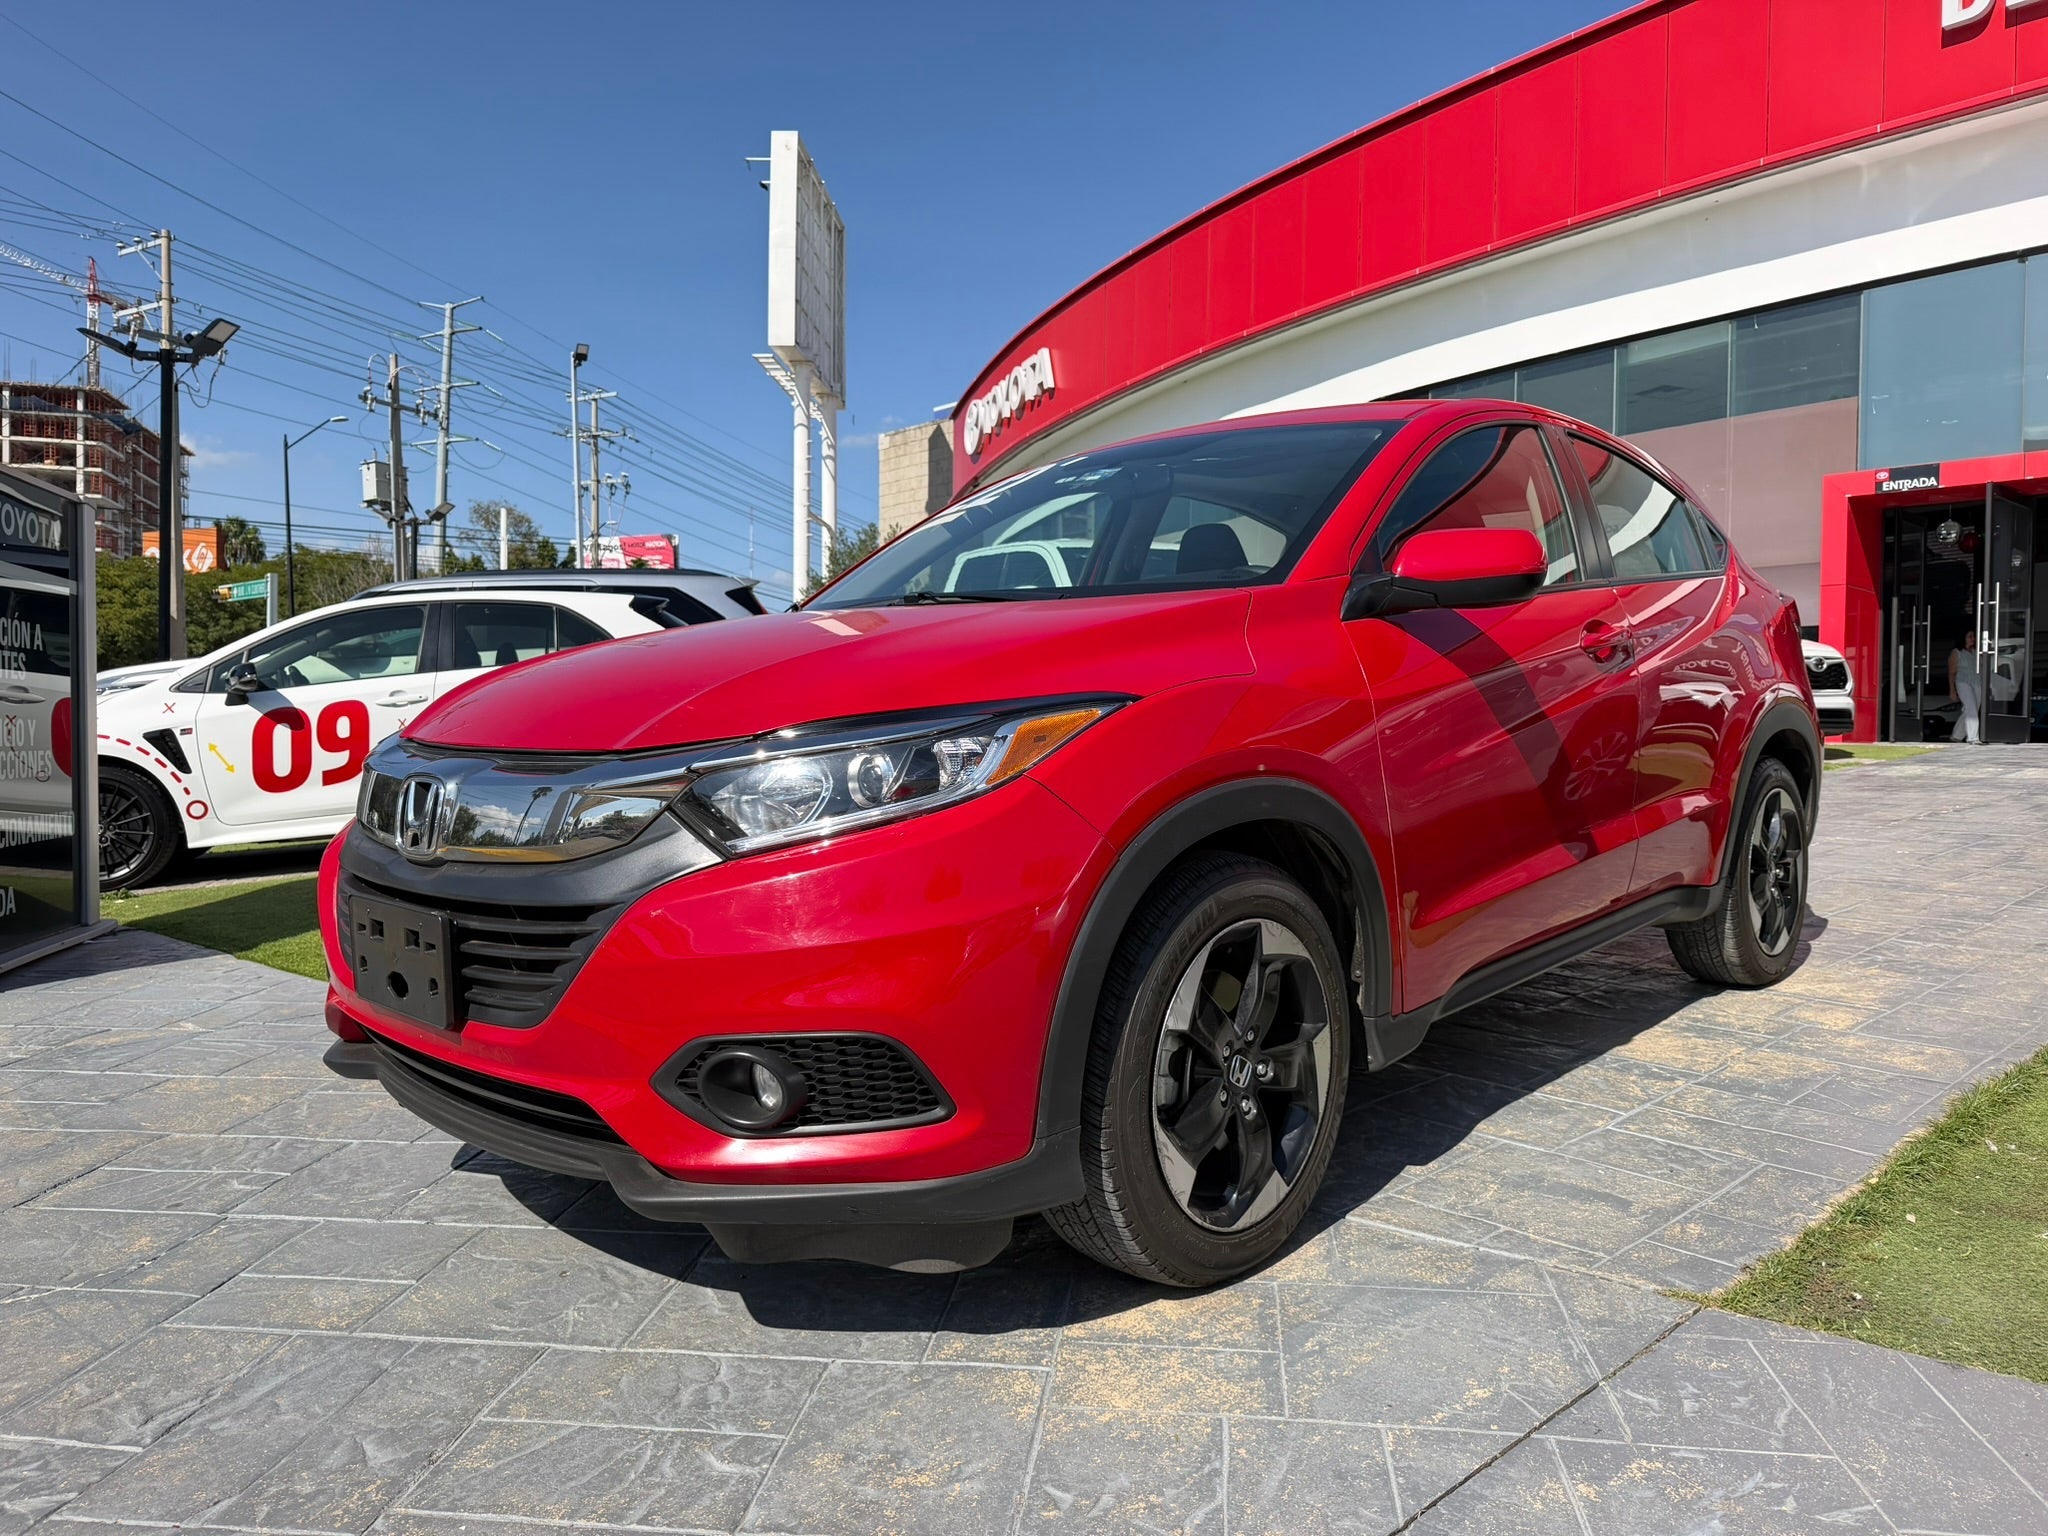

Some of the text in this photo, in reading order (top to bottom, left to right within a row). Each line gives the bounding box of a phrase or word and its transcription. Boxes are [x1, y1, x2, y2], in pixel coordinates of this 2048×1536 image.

[981, 347, 1055, 434] TOYOTA
[1882, 476, 1938, 491] ENTRADA
[0, 502, 61, 551] OYOTA
[0, 612, 43, 651] CIÓN A
[0, 650, 26, 680] TES
[27, 719, 36, 747] Y
[252, 699, 370, 793] 09
